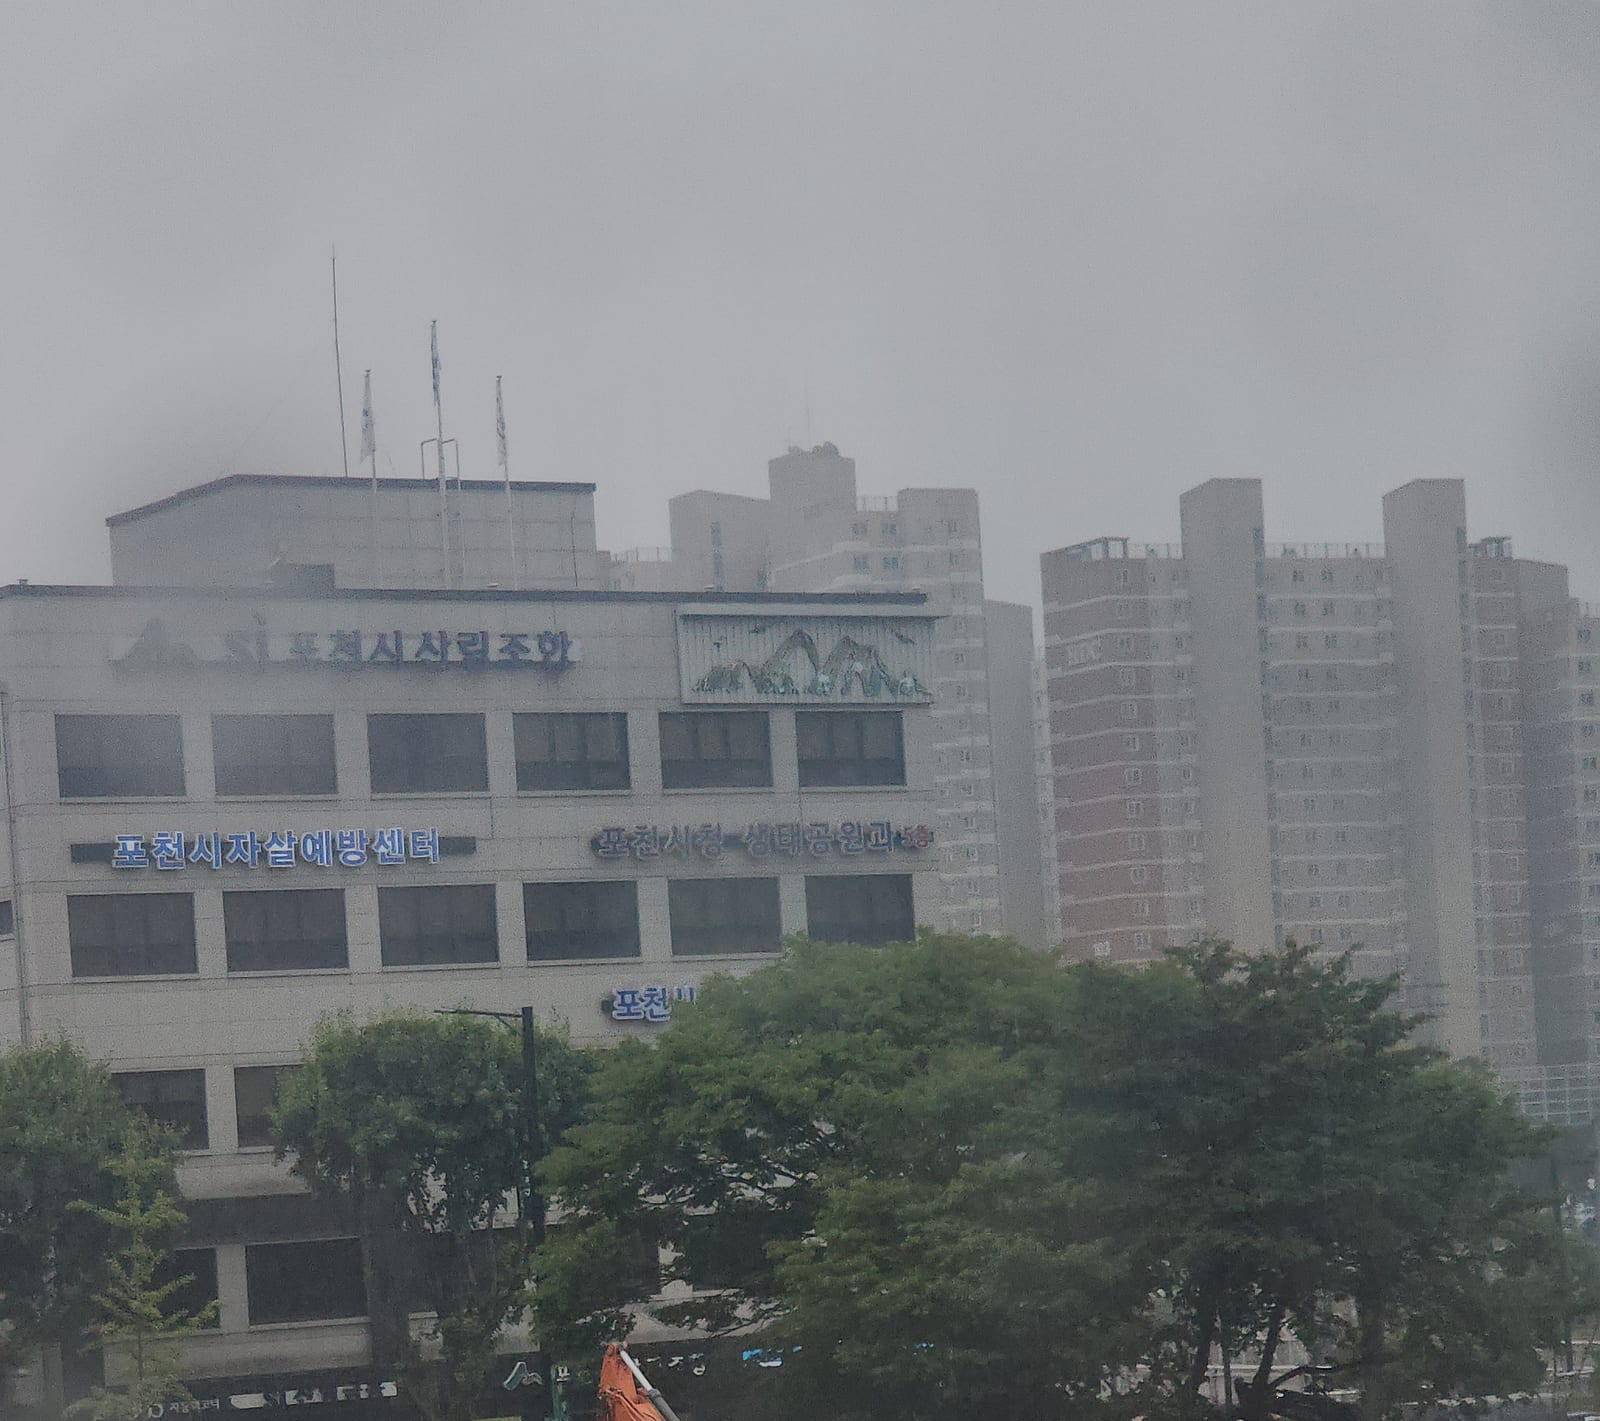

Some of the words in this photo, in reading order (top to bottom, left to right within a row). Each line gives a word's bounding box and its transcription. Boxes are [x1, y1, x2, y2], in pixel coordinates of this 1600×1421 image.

[112, 827, 441, 870] 포천시자살예방센터
[599, 824, 722, 858] 포천시청
[746, 821, 894, 858] 생태공원과
